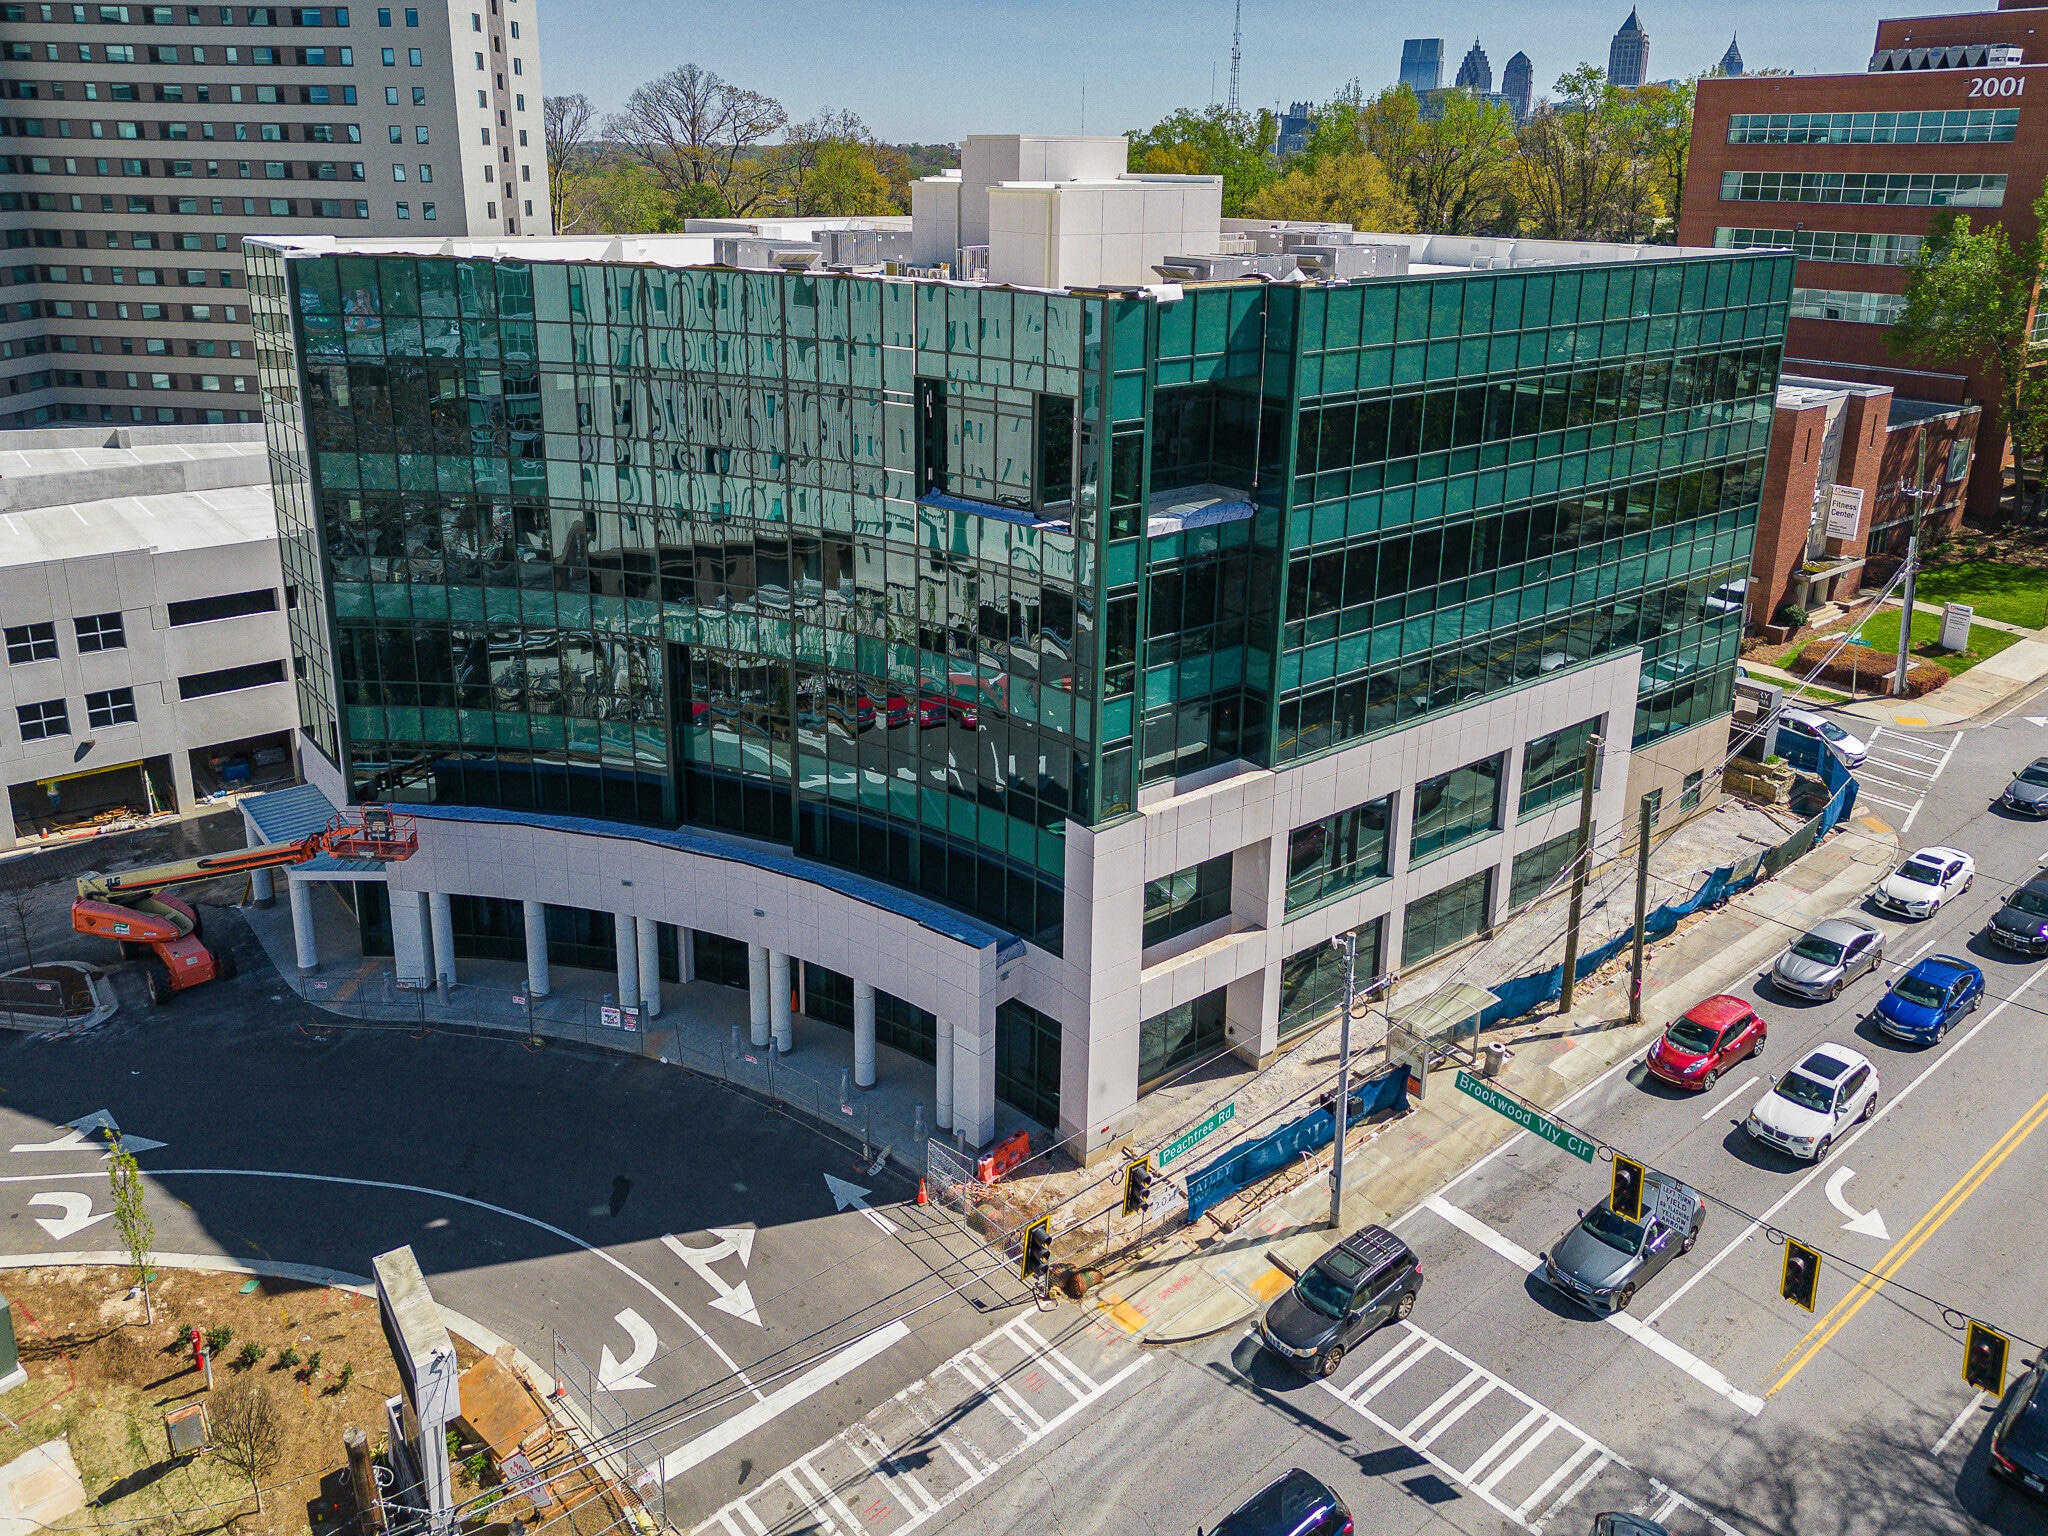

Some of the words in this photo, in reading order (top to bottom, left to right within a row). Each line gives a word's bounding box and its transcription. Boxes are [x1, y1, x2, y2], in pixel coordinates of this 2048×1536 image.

[1968, 76, 2026, 98] 2001
[1831, 508, 1855, 519] Center
[1832, 499, 1857, 511] Fitness
[105, 876, 121, 888] JLG
[1459, 1075, 1531, 1125] Brookwood
[1539, 1119, 1561, 1143] Vly
[1567, 1136, 1590, 1156] Cir
[1163, 1121, 1214, 1163] Peachtree
[1218, 1107, 1231, 1125] Rd
[1663, 1186, 1676, 1197] LEFT
[1677, 1193, 1692, 1206] TURN
[1665, 1194, 1687, 1212] YIELD
[1662, 1208, 1687, 1226] YELLOW
[1667, 1204, 1690, 1221] FLASHING
[1661, 1215, 1684, 1232] ARROW
